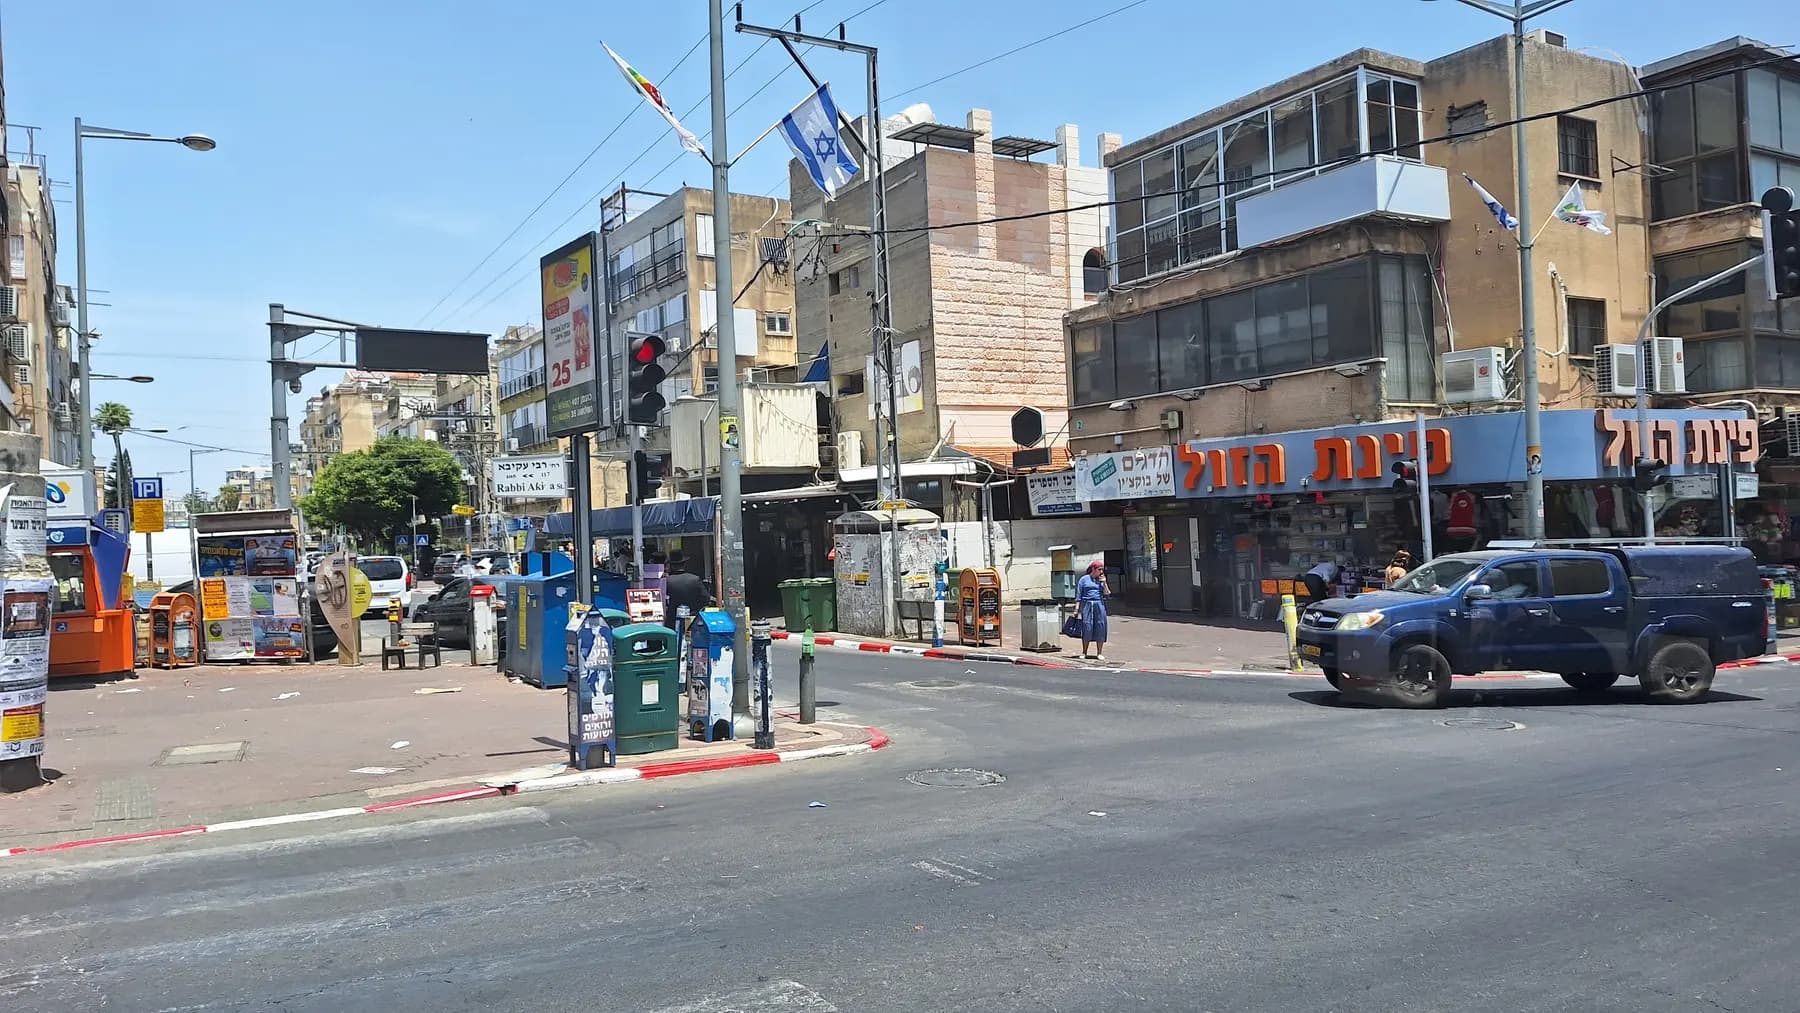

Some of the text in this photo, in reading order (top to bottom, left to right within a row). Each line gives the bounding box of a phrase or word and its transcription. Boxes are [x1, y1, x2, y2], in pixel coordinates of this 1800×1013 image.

[552, 359, 571, 387] 25
[1685, 419, 1760, 464] פינת
[531, 461, 548, 469] רבי
[1122, 452, 1169, 471] הדגים
[1177, 428, 1451, 489] פינת הזול
[498, 462, 529, 471] עקיבא
[1030, 476, 1059, 488] הספרים
[1157, 472, 1170, 486] של
[497, 482, 526, 493] Rabbi
[528, 481, 555, 491] Akia
[582, 729, 613, 741] ישועות
